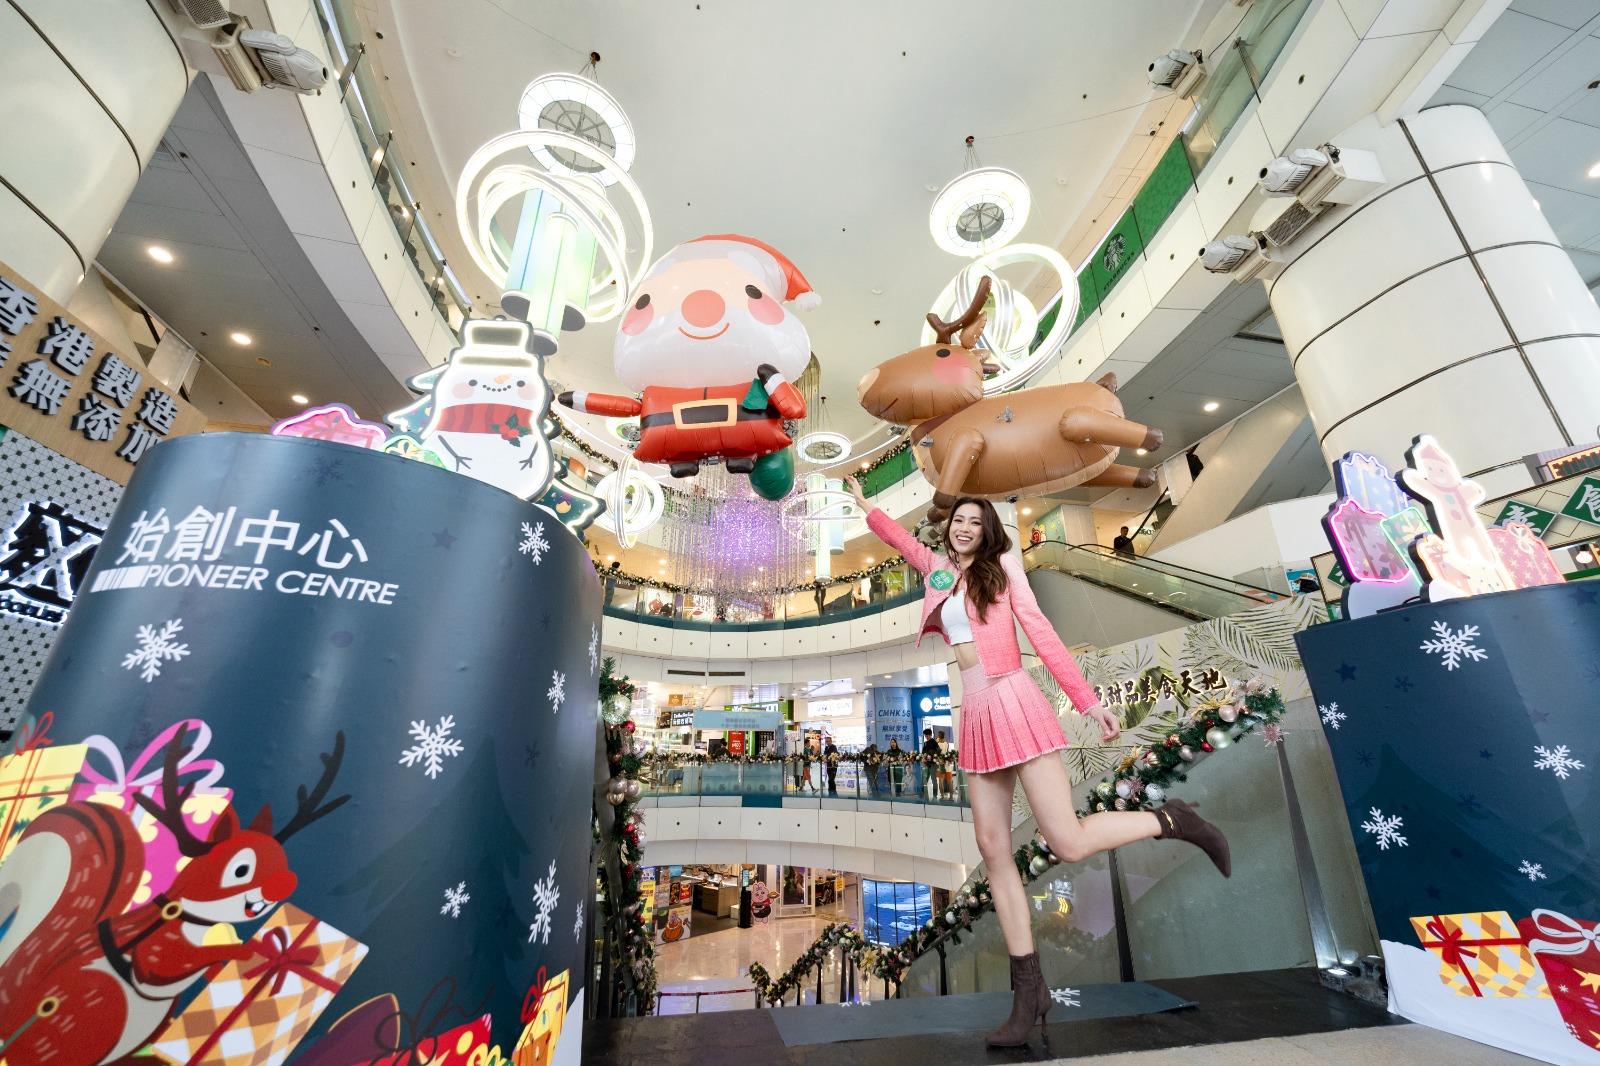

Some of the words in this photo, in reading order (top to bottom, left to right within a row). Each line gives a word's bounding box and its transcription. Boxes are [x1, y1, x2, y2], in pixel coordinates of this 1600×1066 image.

[115, 504, 370, 570] 始創中心
[141, 563, 270, 591] PIONEER
[275, 569, 400, 606] CENTRE
[1080, 668, 1228, 708] 色甜品美食天地
[878, 709, 901, 717] CMHK
